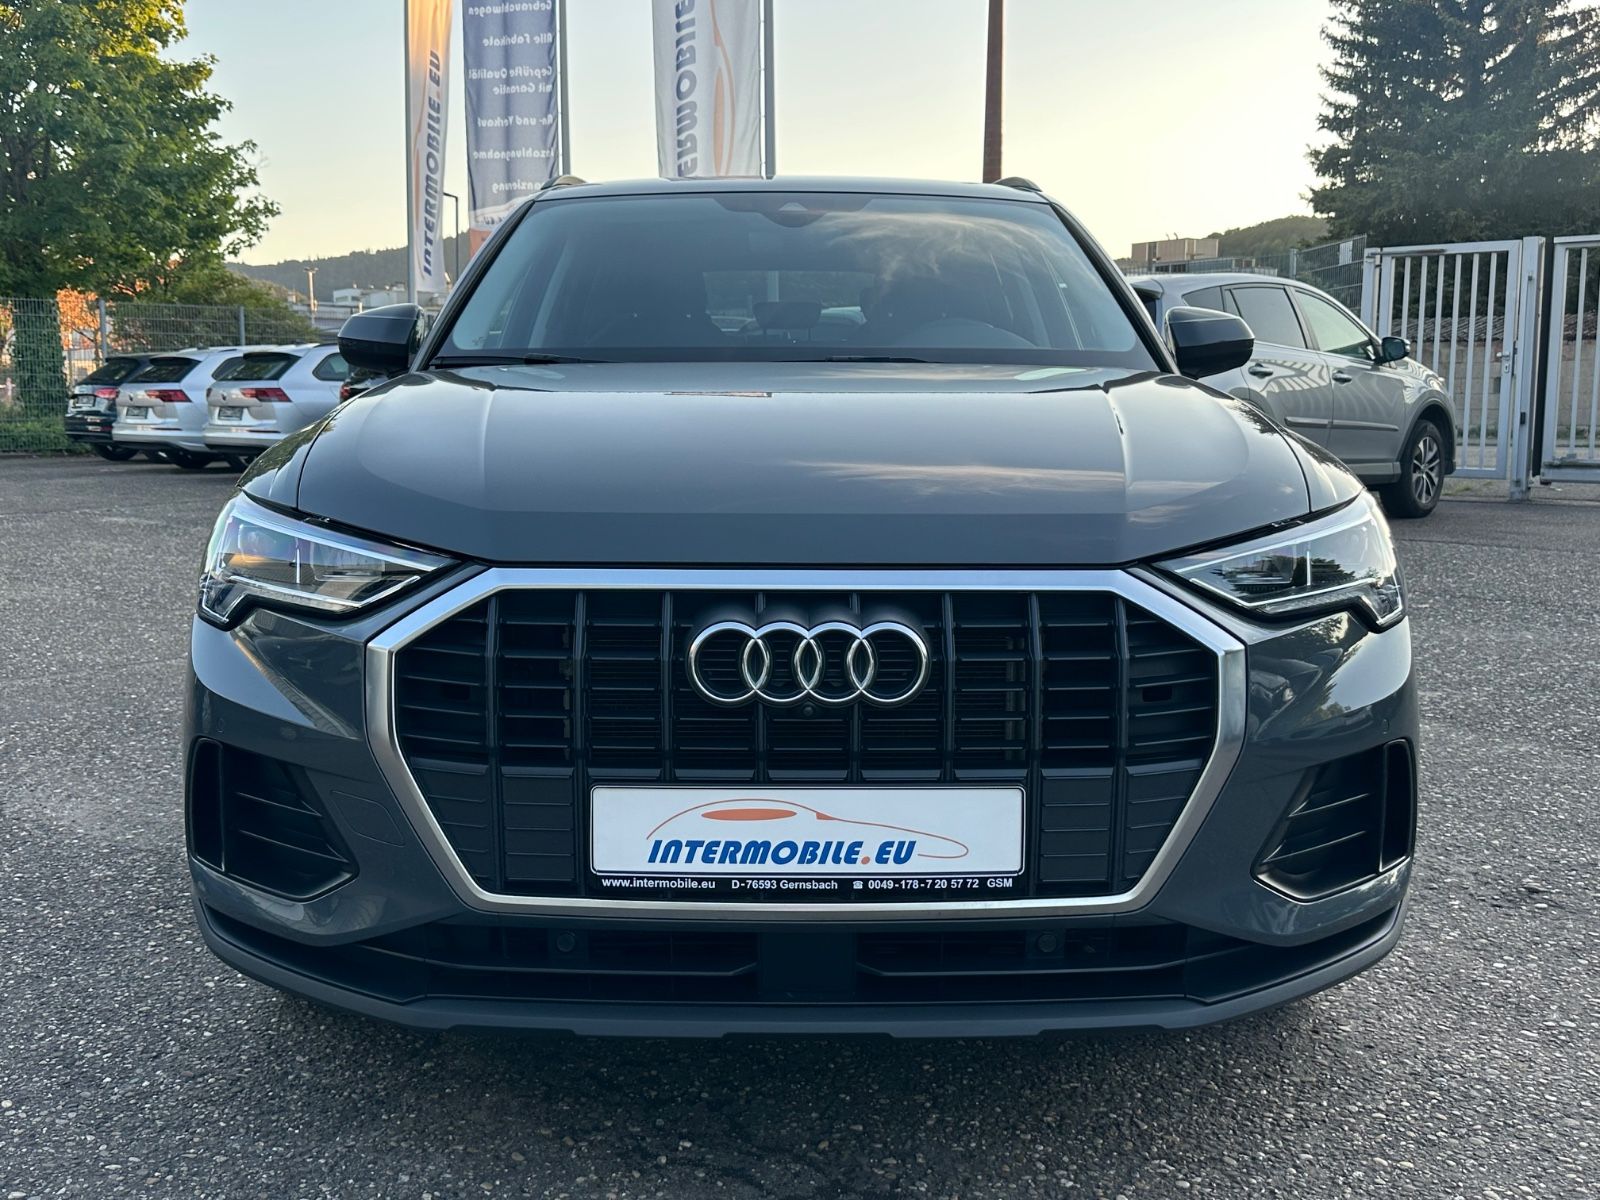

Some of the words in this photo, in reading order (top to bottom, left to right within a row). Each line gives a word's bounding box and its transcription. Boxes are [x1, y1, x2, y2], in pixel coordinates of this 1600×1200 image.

[423, 50, 441, 276] INTERMOBILE.EU
[648, 839, 916, 865] INTERMOBILE.EU
[602, 877, 716, 889] www.intermobile.eu
[731, 879, 777, 890] D-76593
[779, 879, 838, 890] Gernsbach
[987, 878, 1013, 888] GSM
